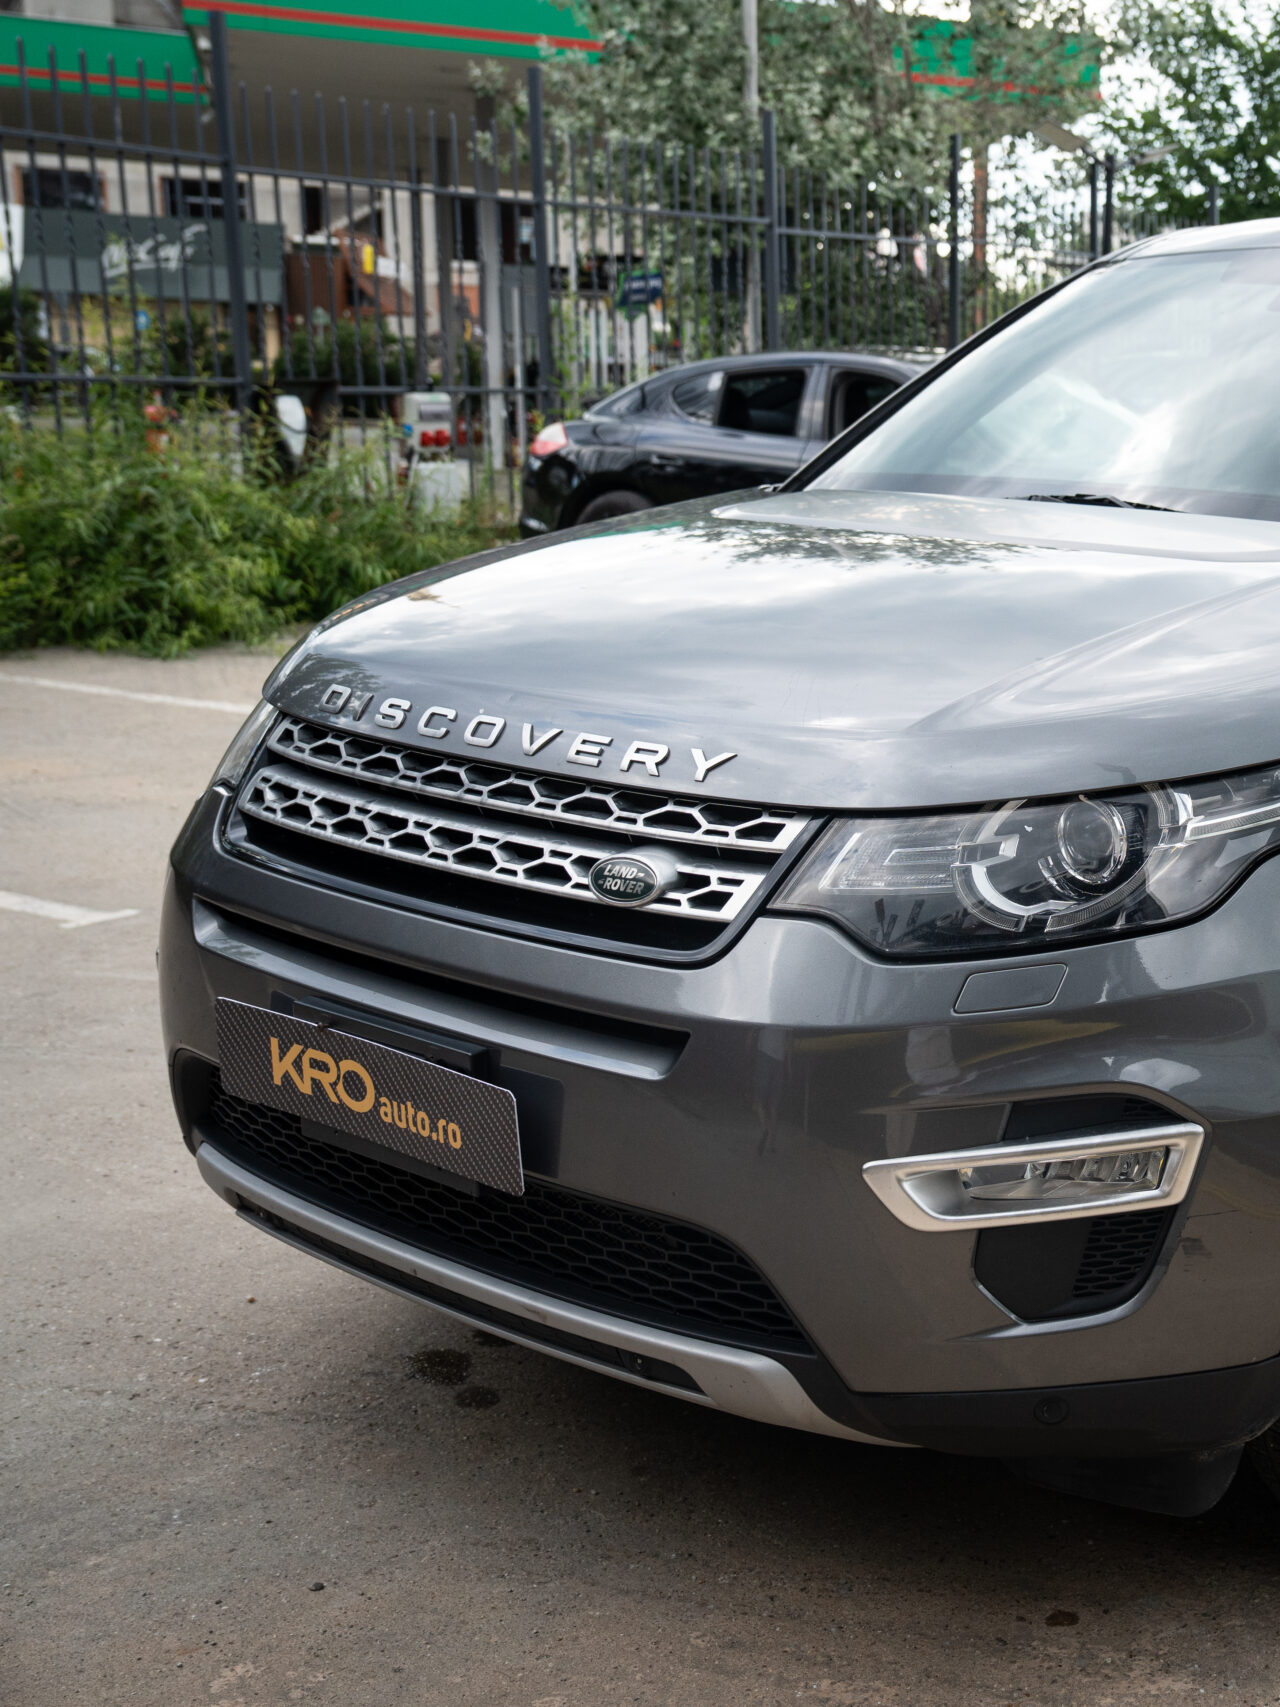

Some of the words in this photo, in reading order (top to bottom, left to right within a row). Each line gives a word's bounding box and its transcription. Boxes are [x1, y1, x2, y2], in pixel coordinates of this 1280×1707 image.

[318, 684, 738, 782] DISCOVERY
[603, 864, 638, 879] LAND
[603, 877, 645, 895] ROVER
[270, 1036, 375, 1113] KRO
[379, 1097, 462, 1149] auto.ro
